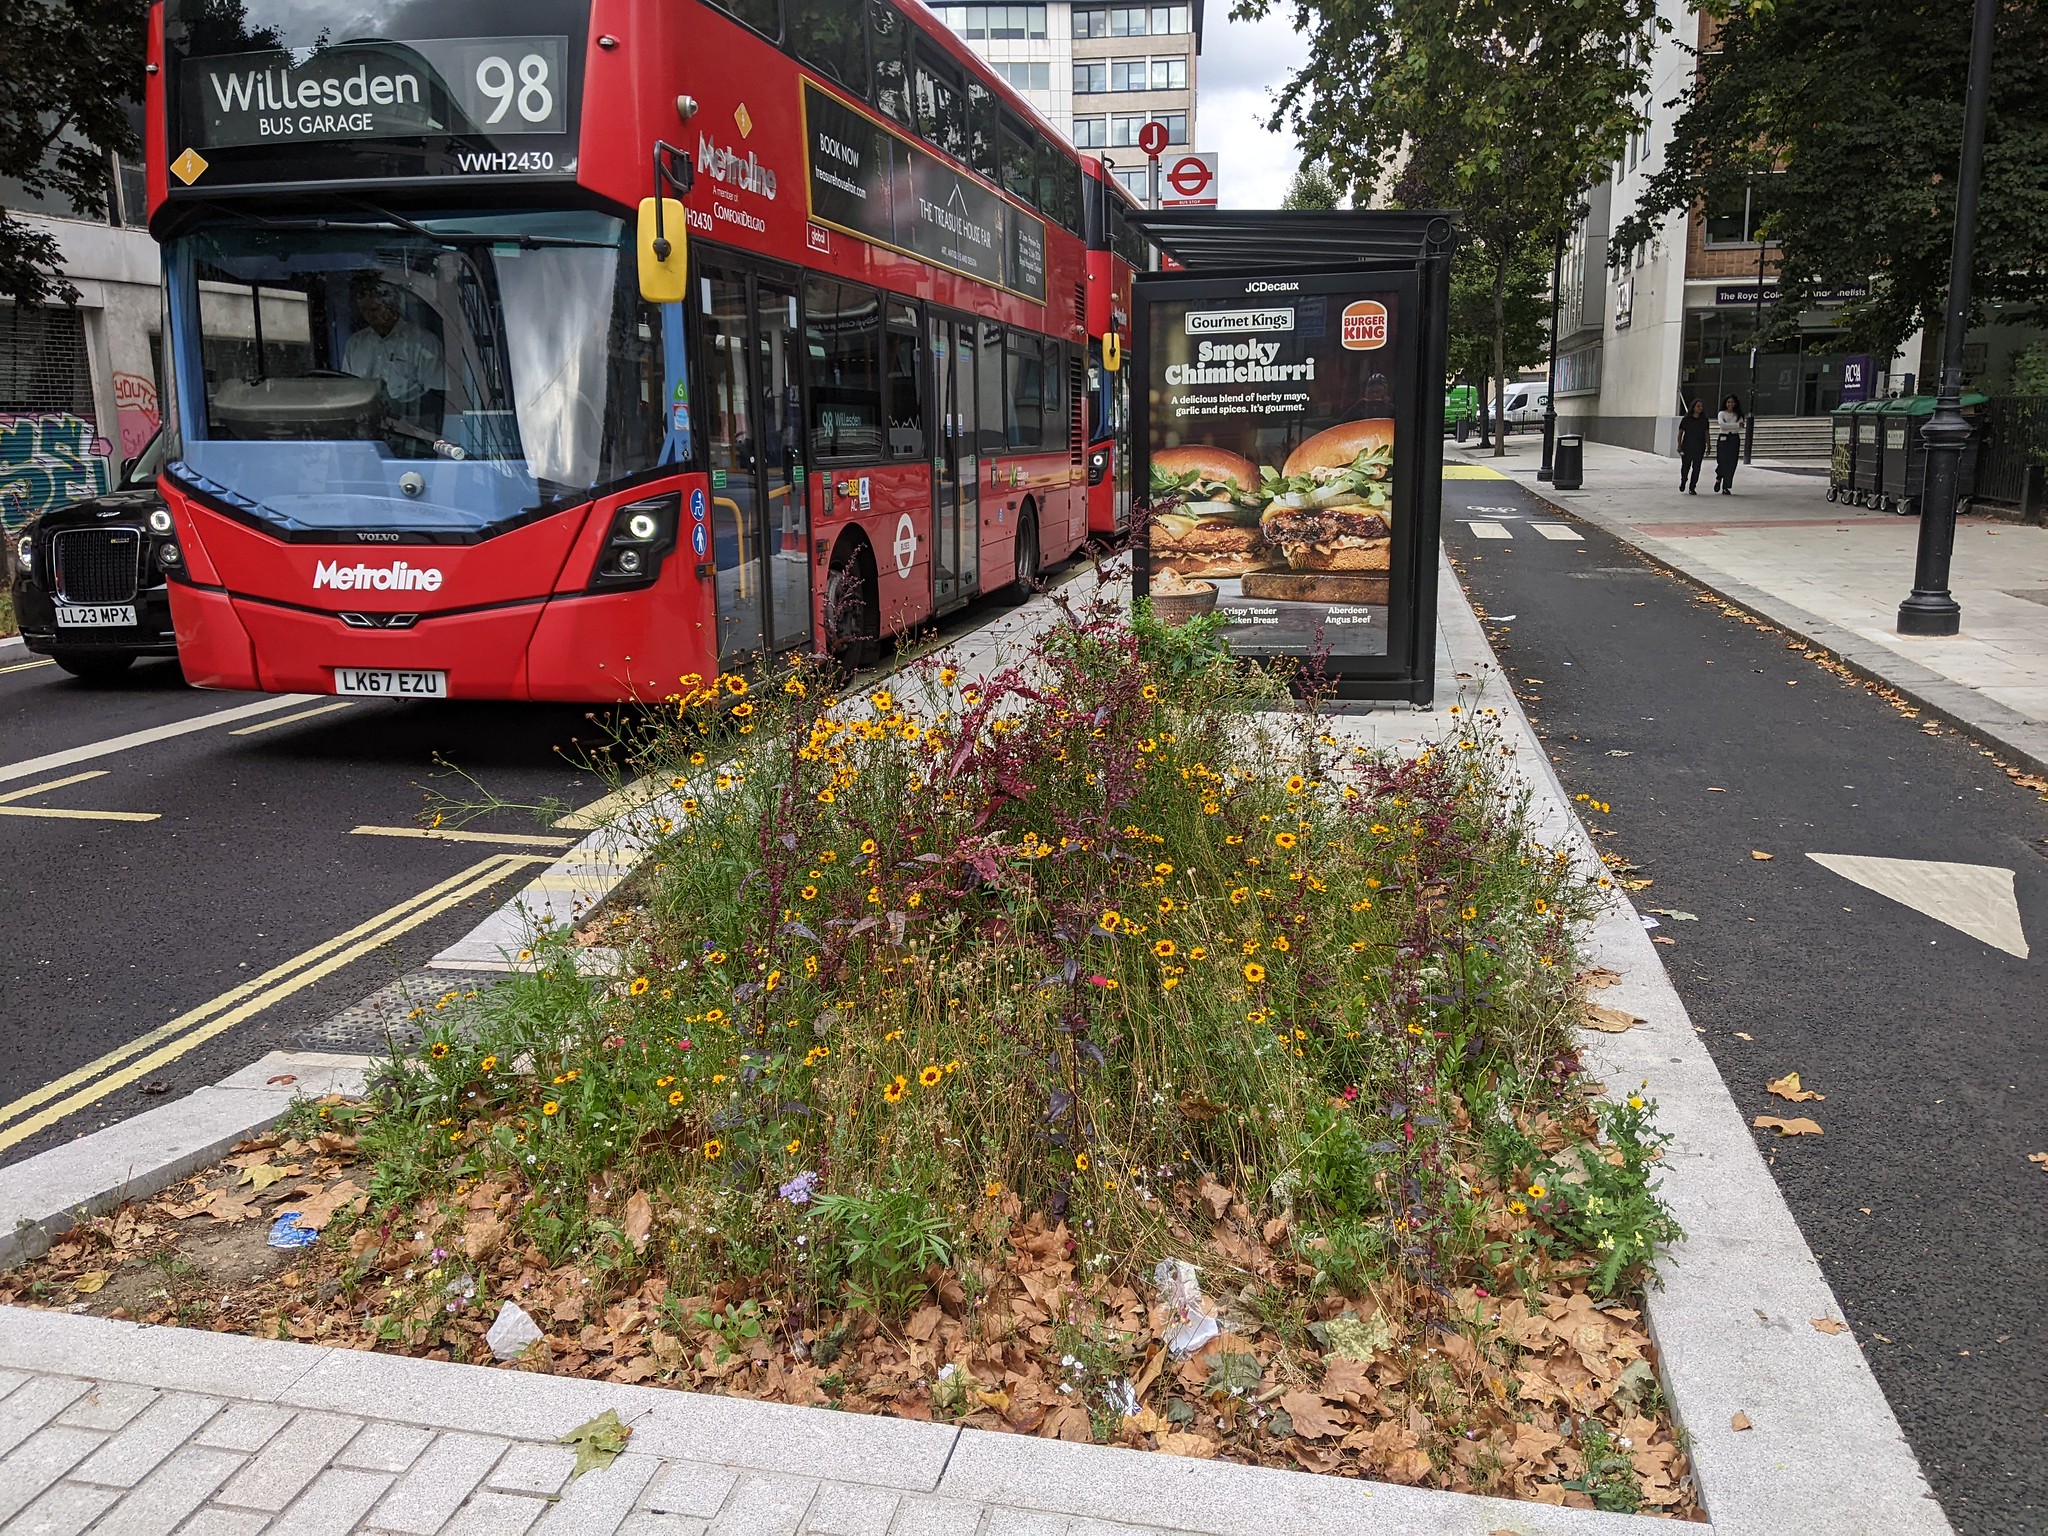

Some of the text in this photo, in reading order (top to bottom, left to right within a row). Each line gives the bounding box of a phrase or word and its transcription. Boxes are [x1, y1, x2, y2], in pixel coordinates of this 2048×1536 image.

[209, 64, 420, 113] Willesden
[475, 54, 553, 125] 98
[259, 113, 374, 136] BUS GARAGE
[1145, 126, 1158, 149] J
[819, 132, 859, 168] BOOK NOW
[457, 152, 554, 173] VWH2430
[698, 130, 777, 200] Metroline
[684, 207, 713, 231] H2430
[919, 197, 933, 222] THE
[962, 218, 980, 244] HOUSE
[1245, 281, 1299, 293] JCDecaux
[1720, 292, 1735, 300] The
[1737, 292, 1759, 301] Roya
[1191, 313, 1288, 329] Gourmet Kings
[1343, 316, 1385, 326] BURGER
[1343, 326, 1385, 340] KING
[1198, 338, 1280, 365] Smoky
[1165, 357, 1315, 385] Chimichurri
[677, 384, 684, 398] 6
[1171, 392, 1310, 405] A delicious blend of herby mayo,
[1175, 406, 1200, 417] garlic
[1201, 405, 1218, 415] and
[1219, 404, 1249, 415] spices.
[1265, 403, 1305, 414] gourmet.
[822, 411, 834, 437] 98
[357, 532, 399, 542] VOLVO
[312, 559, 443, 592] Metroline
[61, 606, 131, 624] LL23 MPX
[1223, 607, 1277, 616] Crispy Tender
[1253, 616, 1279, 624] Breast
[1325, 615, 1371, 625] Angus Beef
[1328, 606, 1368, 615] Aberdeen
[343, 672, 437, 693] LK67 EZU
